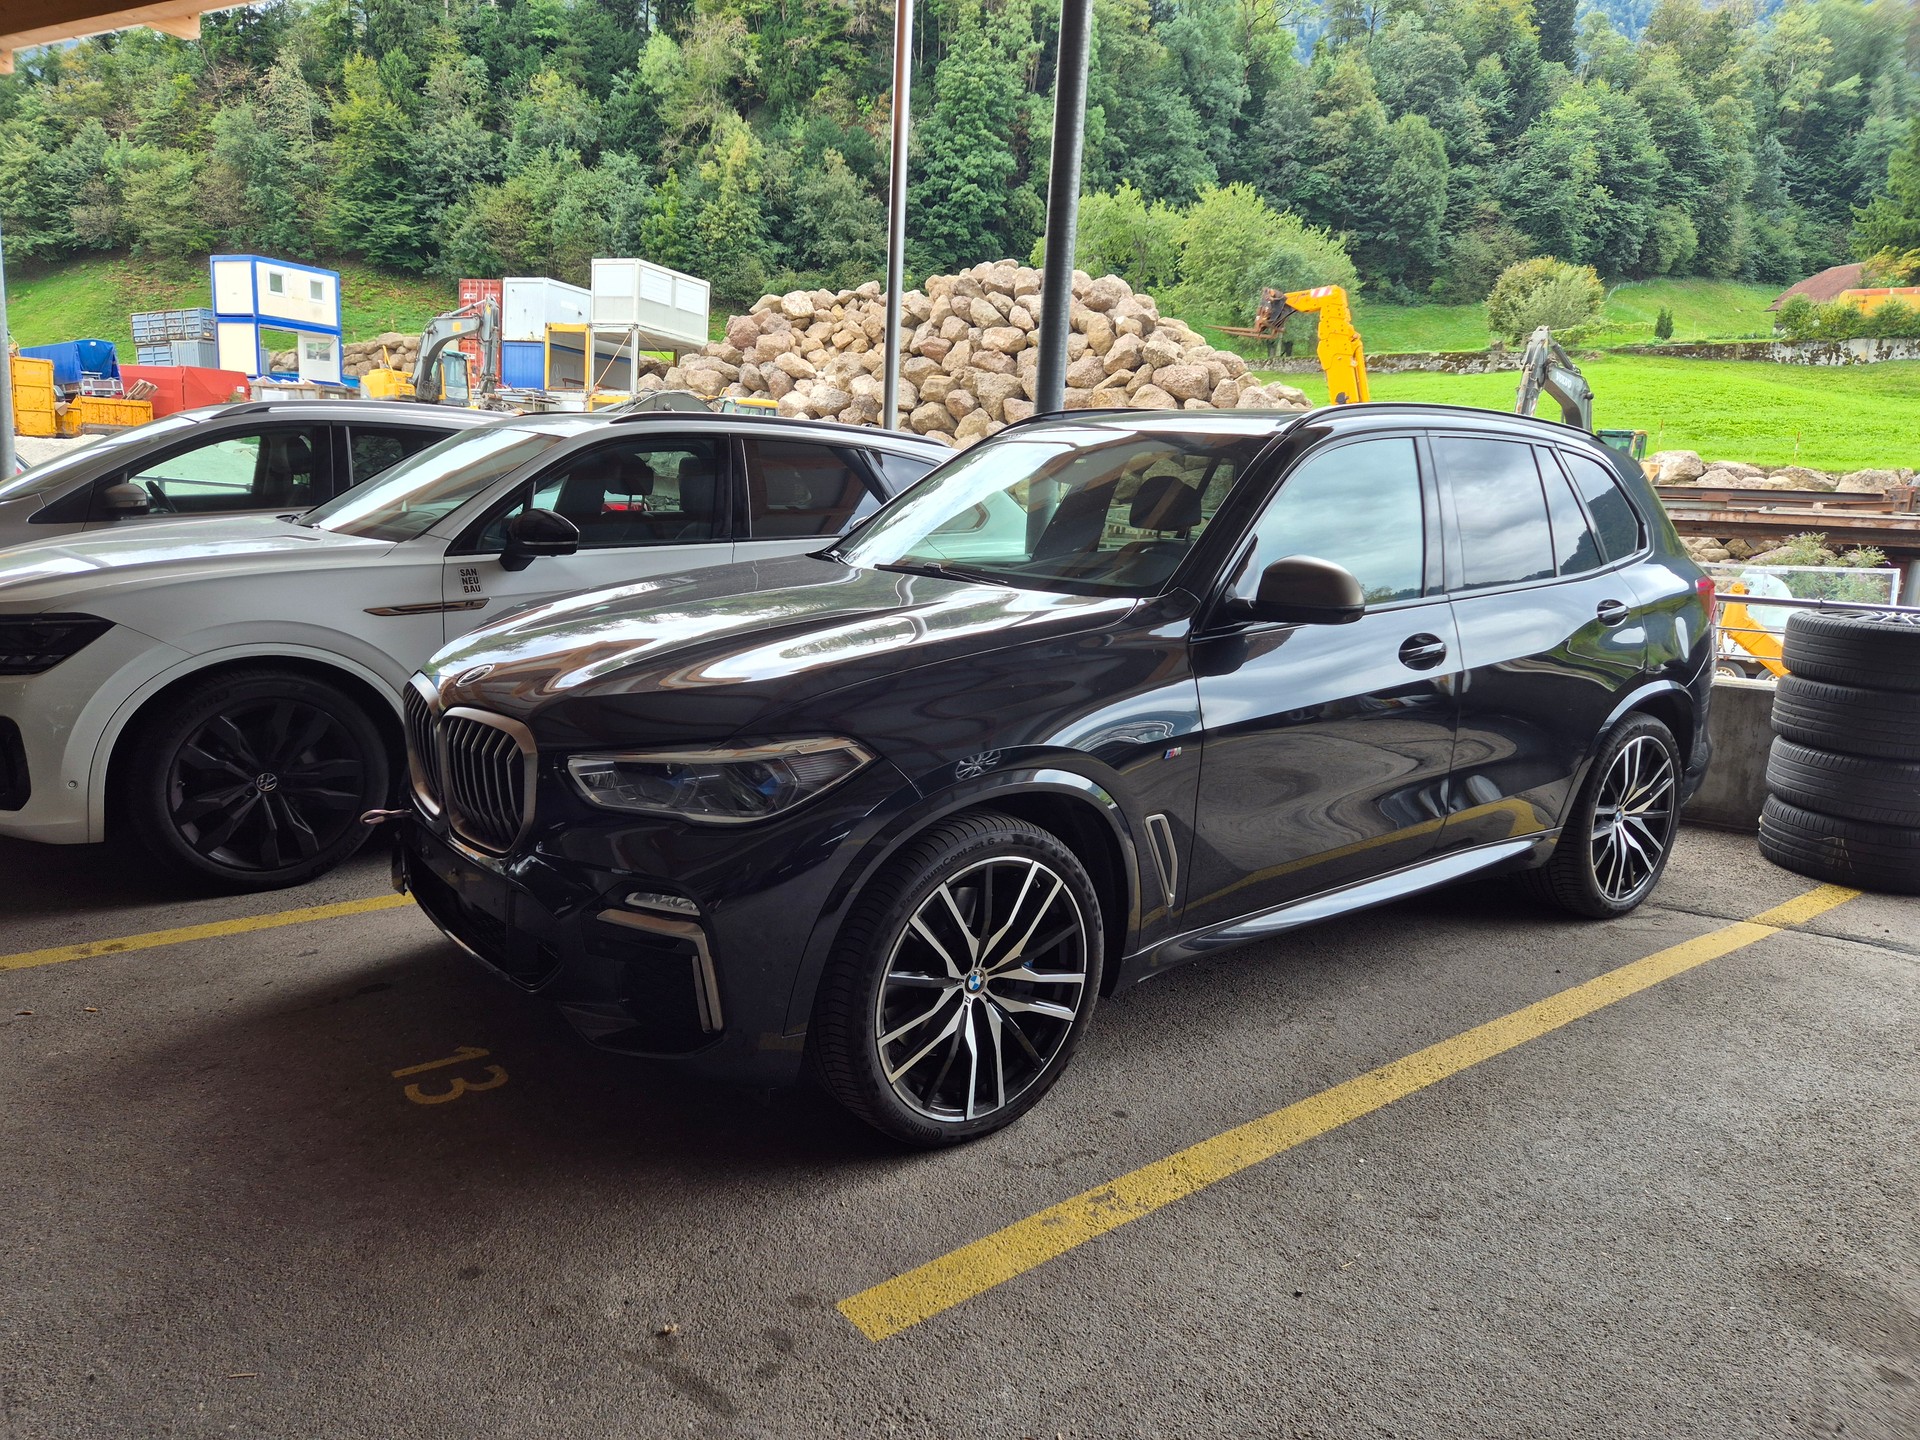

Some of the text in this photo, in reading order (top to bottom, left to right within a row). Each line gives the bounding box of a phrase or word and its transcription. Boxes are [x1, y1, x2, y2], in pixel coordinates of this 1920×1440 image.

[460, 568, 477, 576] SAN
[462, 576, 479, 585] NEU
[463, 584, 481, 593] BAU
[899, 837, 996, 909] PremiumContact 6
[391, 1046, 509, 1105] 13
